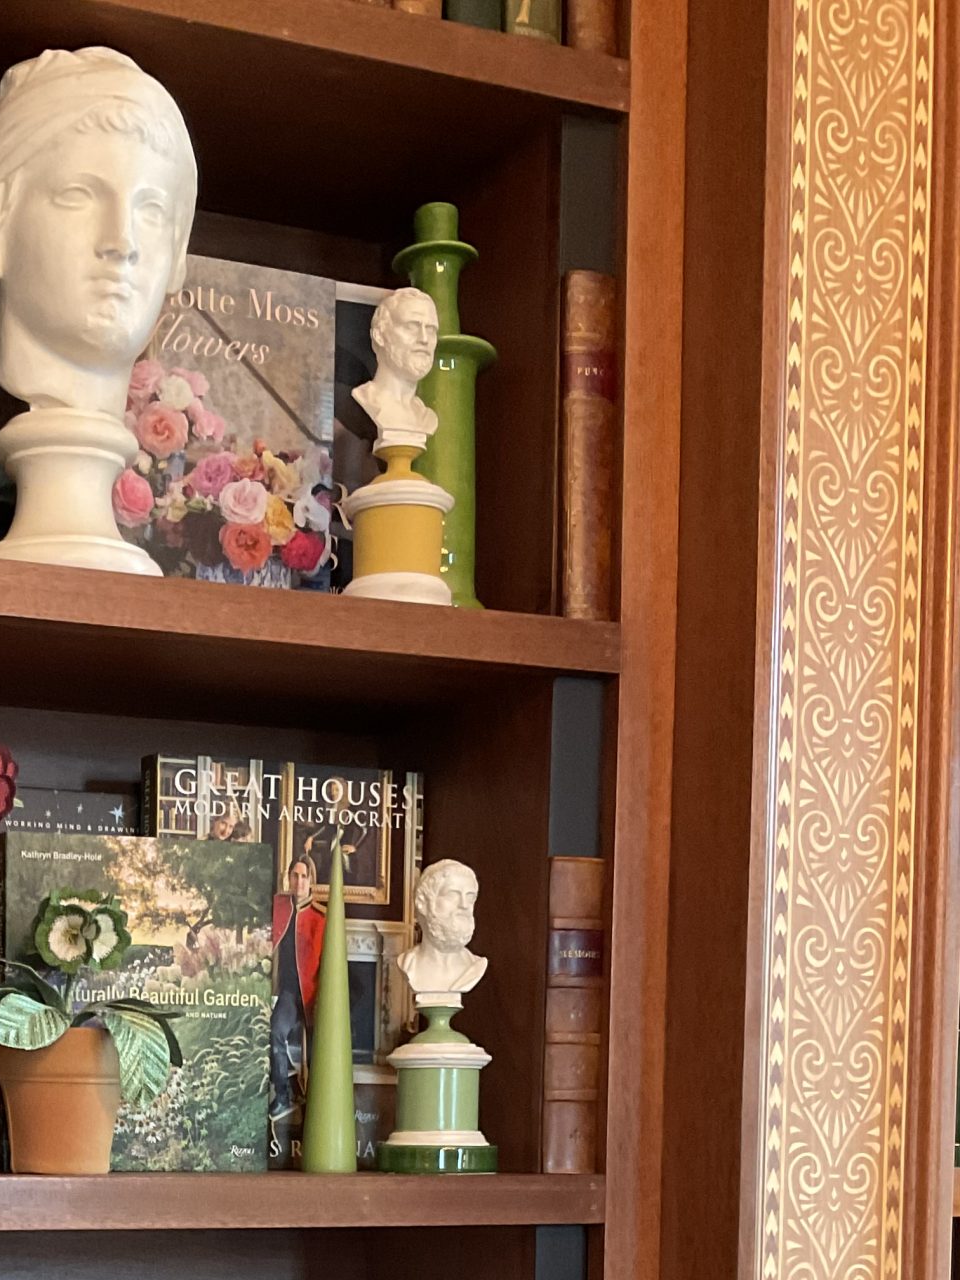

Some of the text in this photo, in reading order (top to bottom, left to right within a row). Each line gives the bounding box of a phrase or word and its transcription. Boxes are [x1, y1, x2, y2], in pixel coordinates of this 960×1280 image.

[248, 288, 320, 330] Moss
[174, 768, 414, 811] GREAT HOUSES
[5, 819, 52, 830] WORKING
[56, 822, 83, 832] MIND
[174, 799, 414, 830] MODERN ARISTOCRATS
[21, 850, 103, 862] Kathryn Bradley-Hole
[129, 986, 199, 1006] Beautiful
[204, 988, 259, 1008] Garden
[201, 1012, 227, 1020] NATURE
